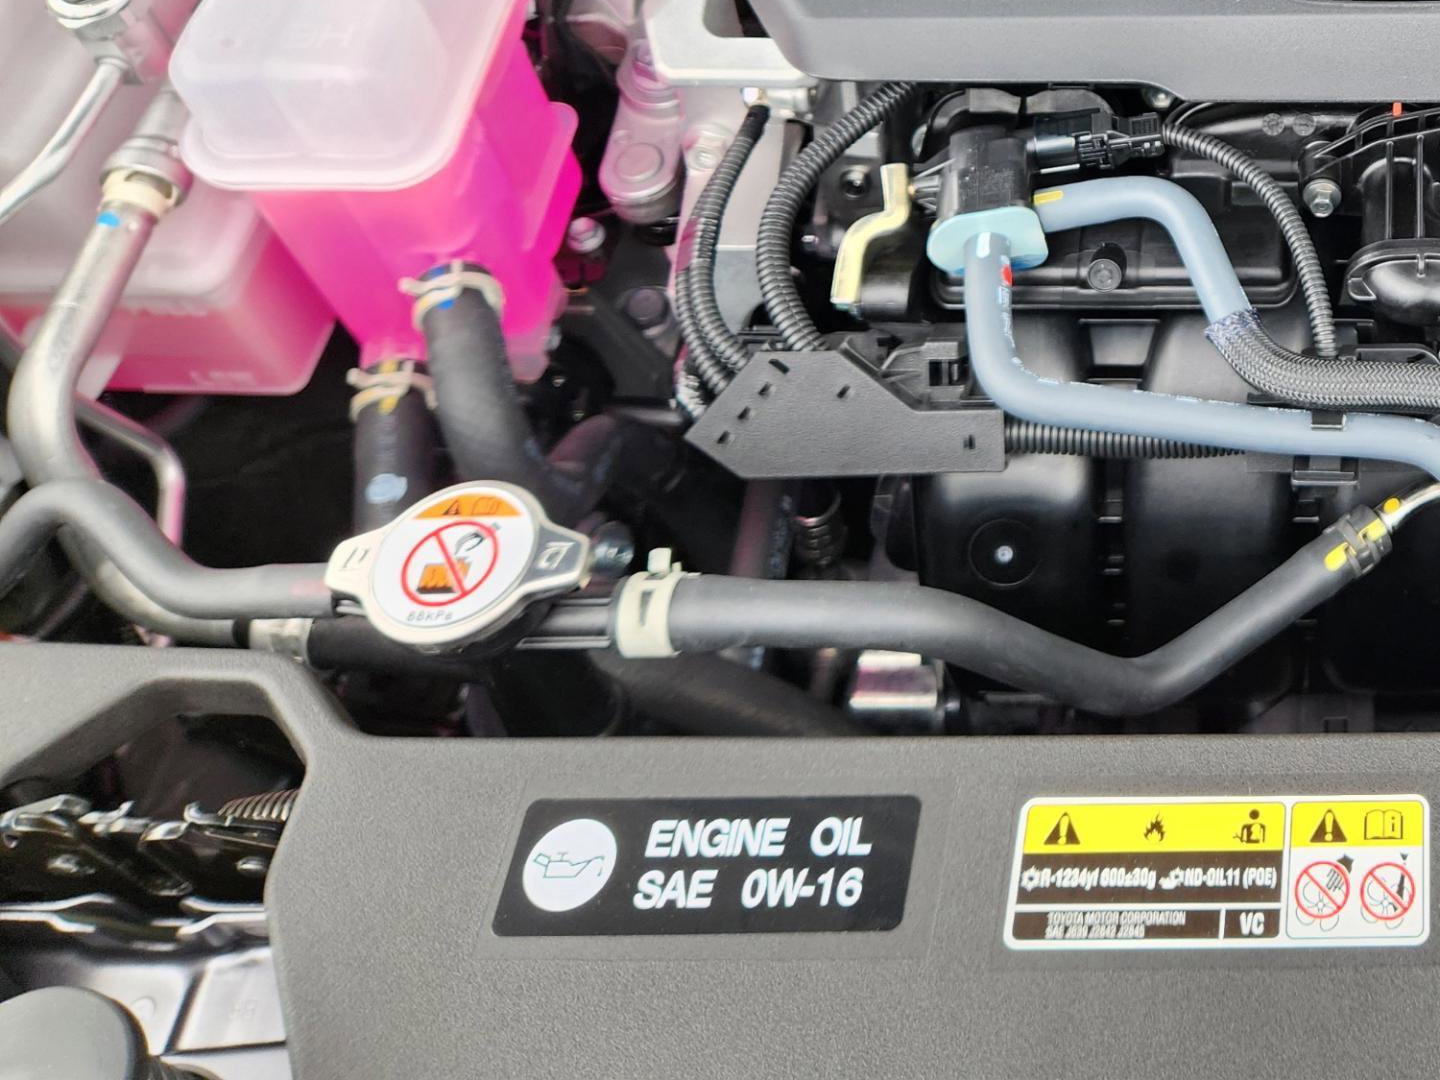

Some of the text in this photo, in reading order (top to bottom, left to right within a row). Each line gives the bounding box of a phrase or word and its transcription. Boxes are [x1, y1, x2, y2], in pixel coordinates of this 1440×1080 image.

[644, 816, 873, 858] ENGINE OIL
[632, 867, 864, 910] SAE 0W-16
[1242, 866, 1277, 889] (POE)
[1047, 910, 1187, 926] TOYOTA MOTOR CORPORATION
[1239, 911, 1265, 935] VC
[1045, 925, 1064, 939] SAE
